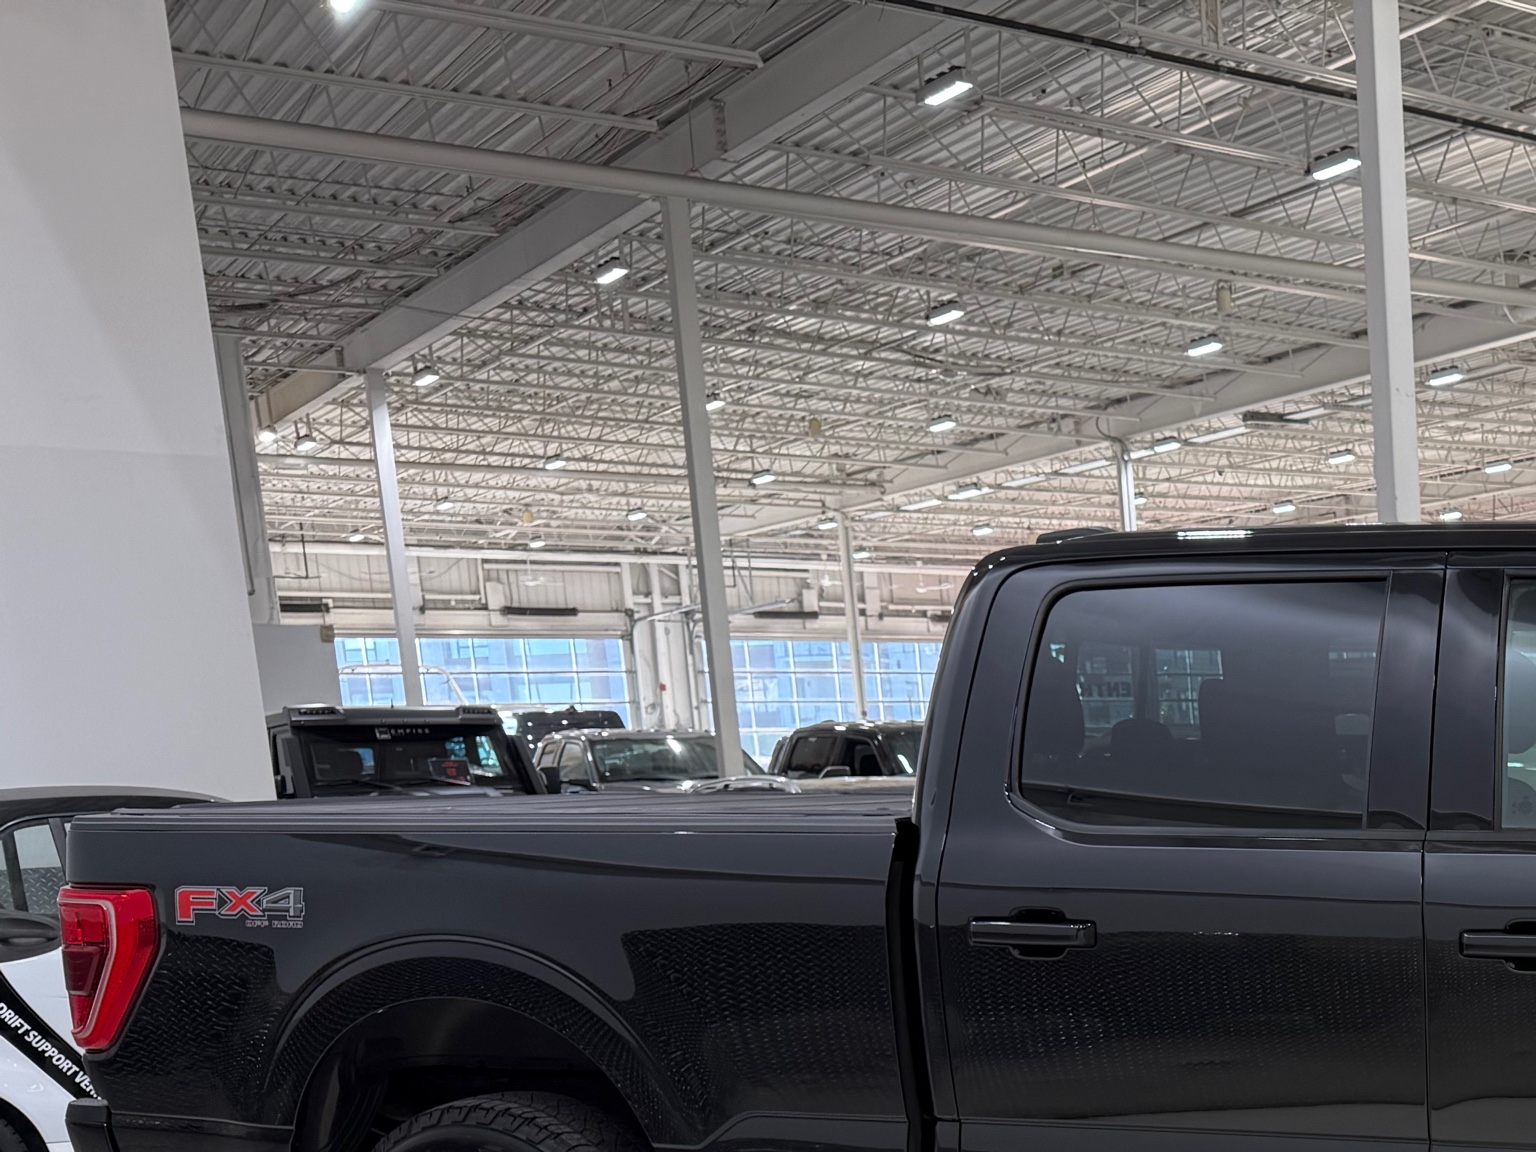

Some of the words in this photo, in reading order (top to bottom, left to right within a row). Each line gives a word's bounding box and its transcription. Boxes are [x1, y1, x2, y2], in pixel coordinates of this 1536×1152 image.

[175, 886, 305, 925] FX4
[0, 1002, 31, 1034] DRIFT
[24, 1030, 80, 1076] SUPPORT
